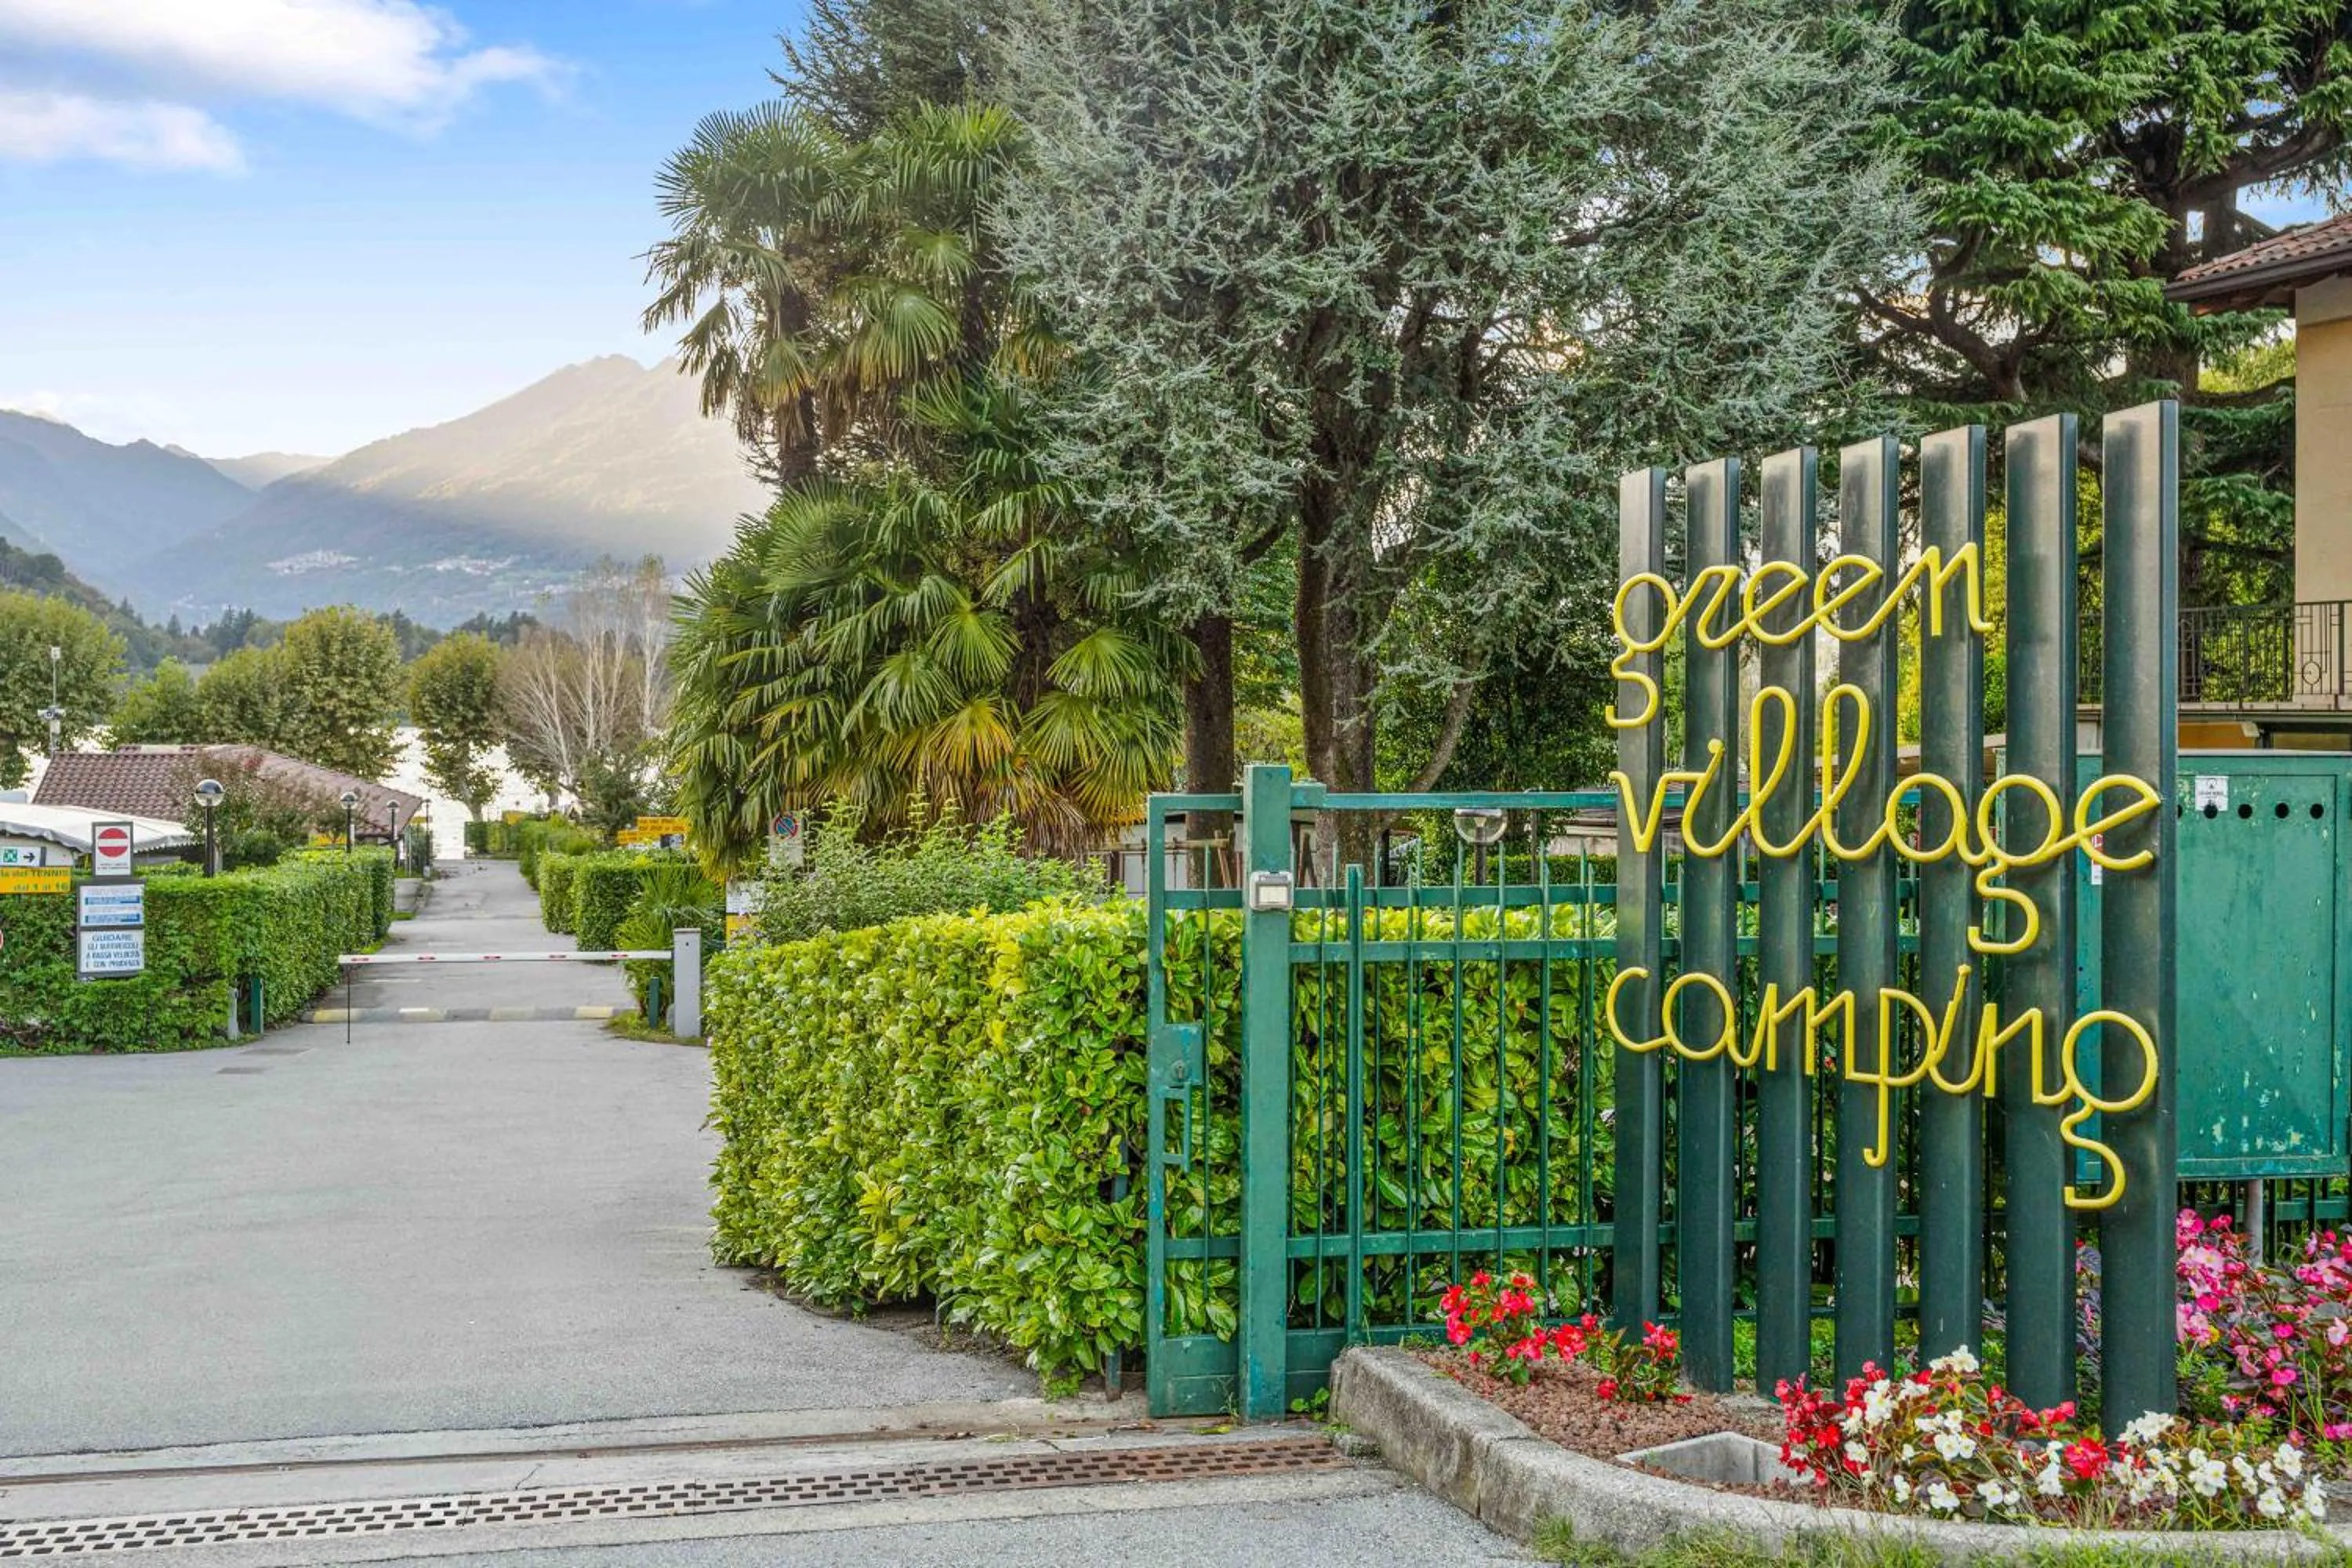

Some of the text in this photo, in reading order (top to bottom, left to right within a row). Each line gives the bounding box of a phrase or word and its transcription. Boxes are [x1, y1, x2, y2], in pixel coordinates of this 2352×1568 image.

[1605, 542, 1994, 728] green
[1609, 684, 2161, 954] village
[1606, 964, 2159, 1209] camping
